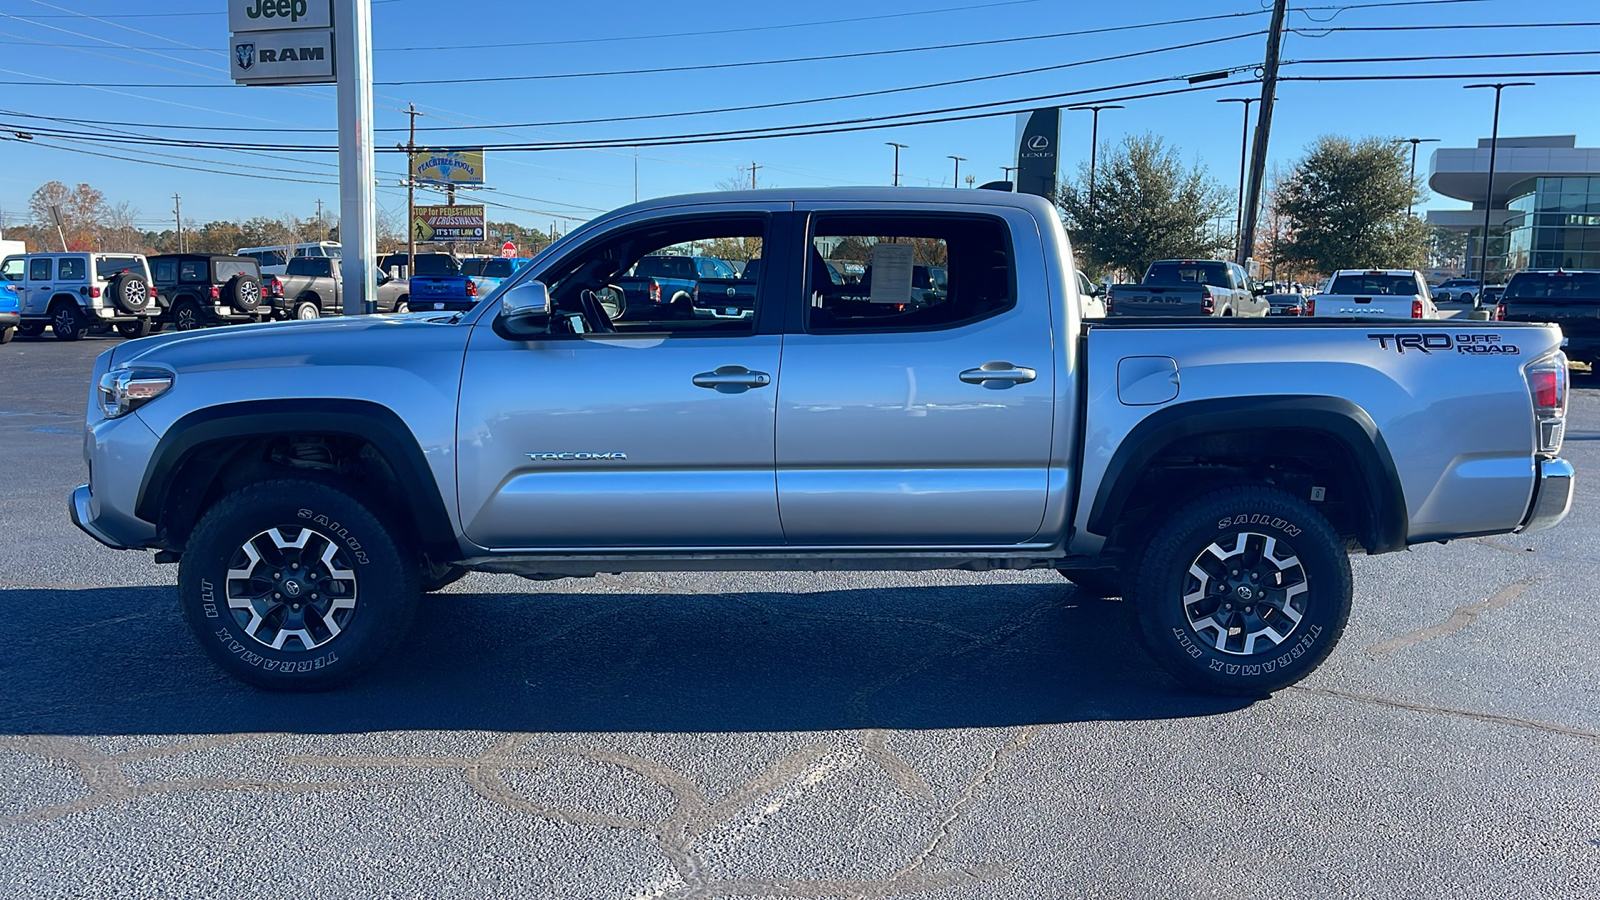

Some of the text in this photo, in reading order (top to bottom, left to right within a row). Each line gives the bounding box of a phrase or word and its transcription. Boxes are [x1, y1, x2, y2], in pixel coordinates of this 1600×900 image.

[246, 0, 307, 22] Jeep
[259, 47, 324, 62] RAM
[417, 158, 476, 175] PEACHTREE POOLS
[428, 207, 438, 216] for
[440, 207, 483, 216] PEDESTRIANS
[428, 216, 483, 225] IN CROSSWALKS
[436, 228, 474, 236] IT'S THE LAW
[502, 249, 516, 257] STOP
[1132, 295, 1182, 303] RAM
[1367, 333, 1501, 355] TRD OFF
[1457, 344, 1520, 355] ROAD
[525, 451, 628, 461] TACOMA
[1218, 513, 1302, 537] SAILUN
[297, 508, 370, 565] SAILUN
[201, 578, 339, 673] TERRAMAX HLT
[1172, 624, 1323, 676] TERRAMAX HLT
